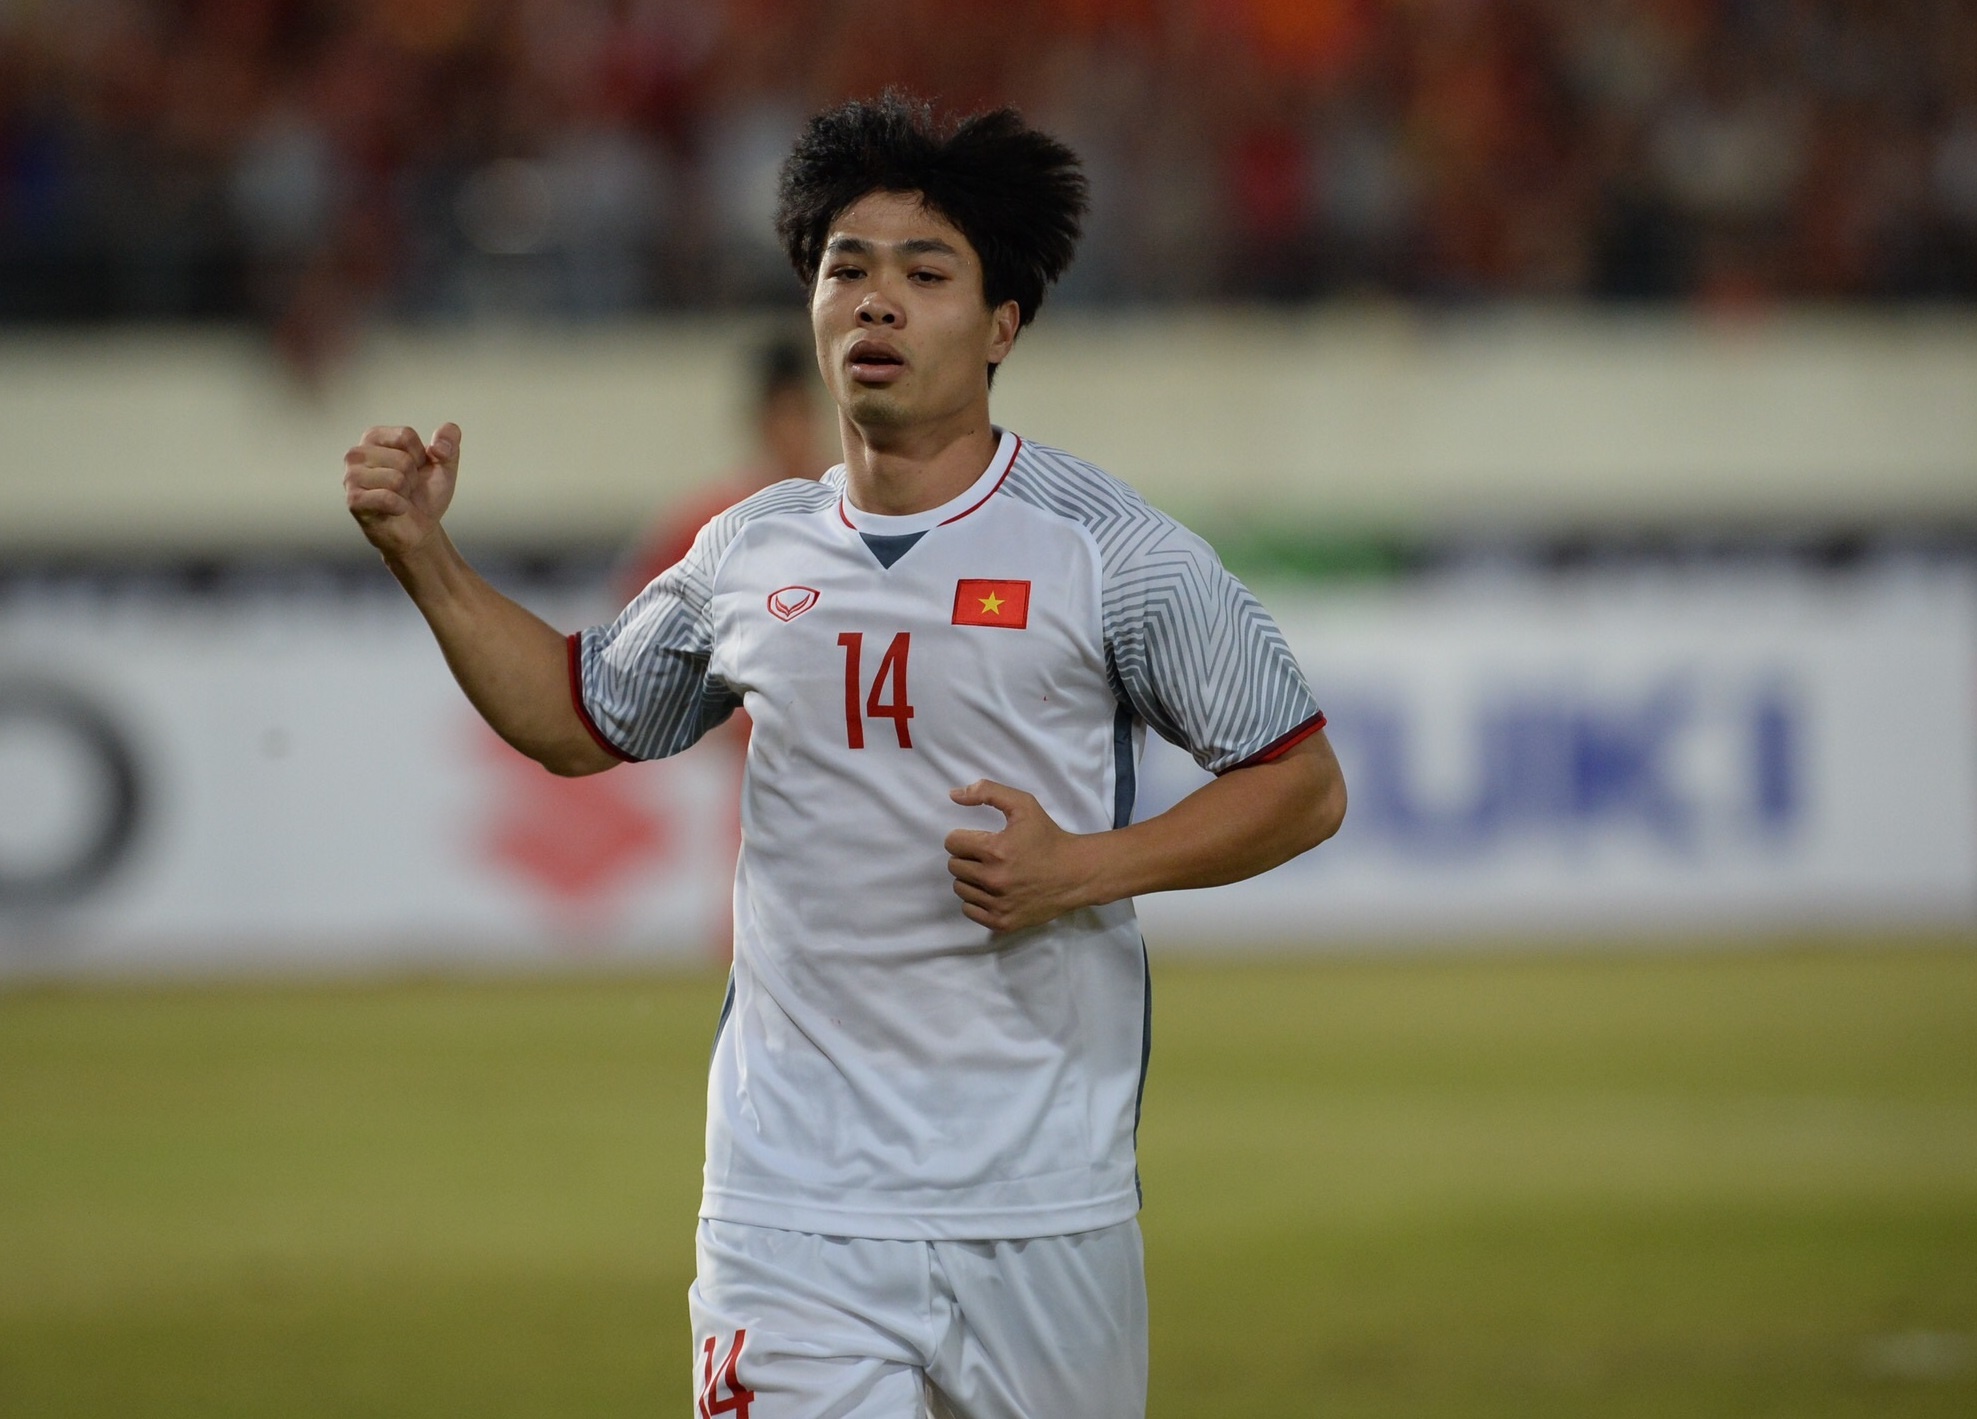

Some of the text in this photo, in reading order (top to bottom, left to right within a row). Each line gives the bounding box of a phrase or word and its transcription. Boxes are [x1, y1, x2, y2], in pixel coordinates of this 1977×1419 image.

[837, 631, 914, 749] 14
[1318, 678, 1806, 862] UKI
[699, 1329, 755, 1419] 14
